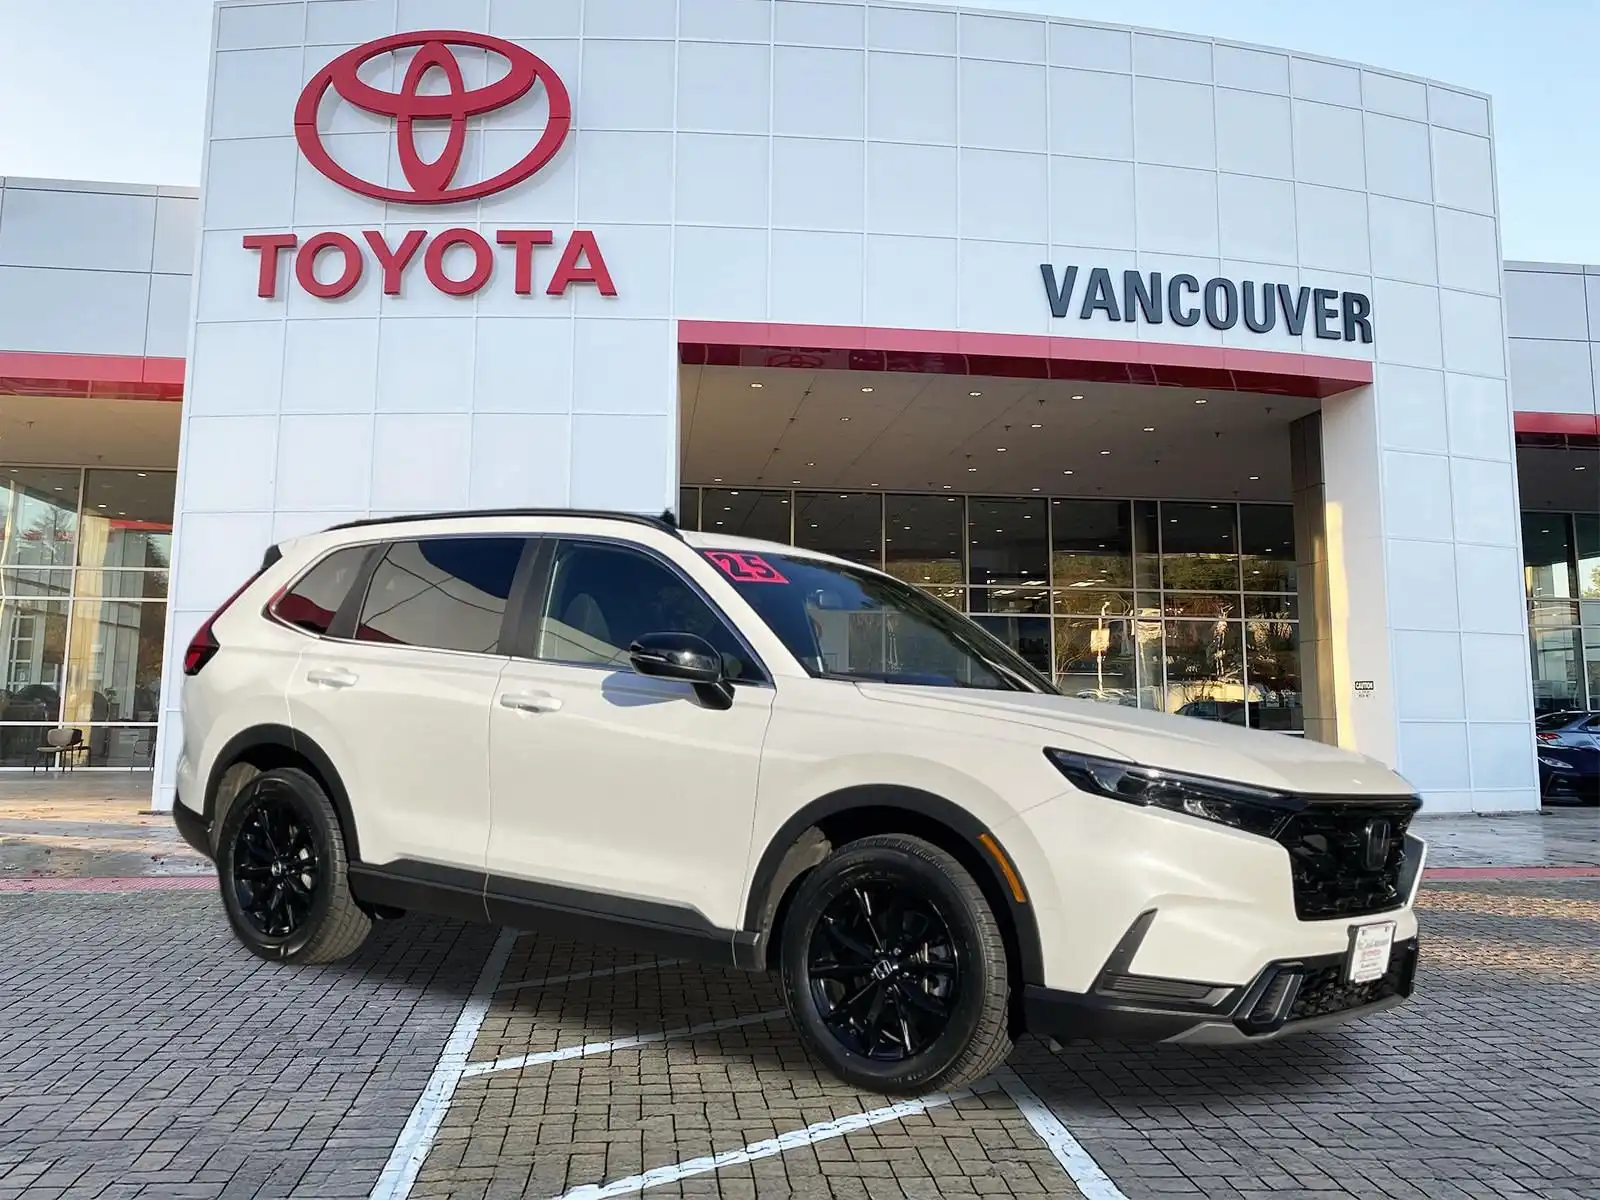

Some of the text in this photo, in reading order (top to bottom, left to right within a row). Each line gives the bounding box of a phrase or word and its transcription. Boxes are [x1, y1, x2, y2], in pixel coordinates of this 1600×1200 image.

[243, 228, 617, 298] TOYOTA
[1040, 264, 1373, 343] VANCOUVER
[711, 553, 776, 579] 25
